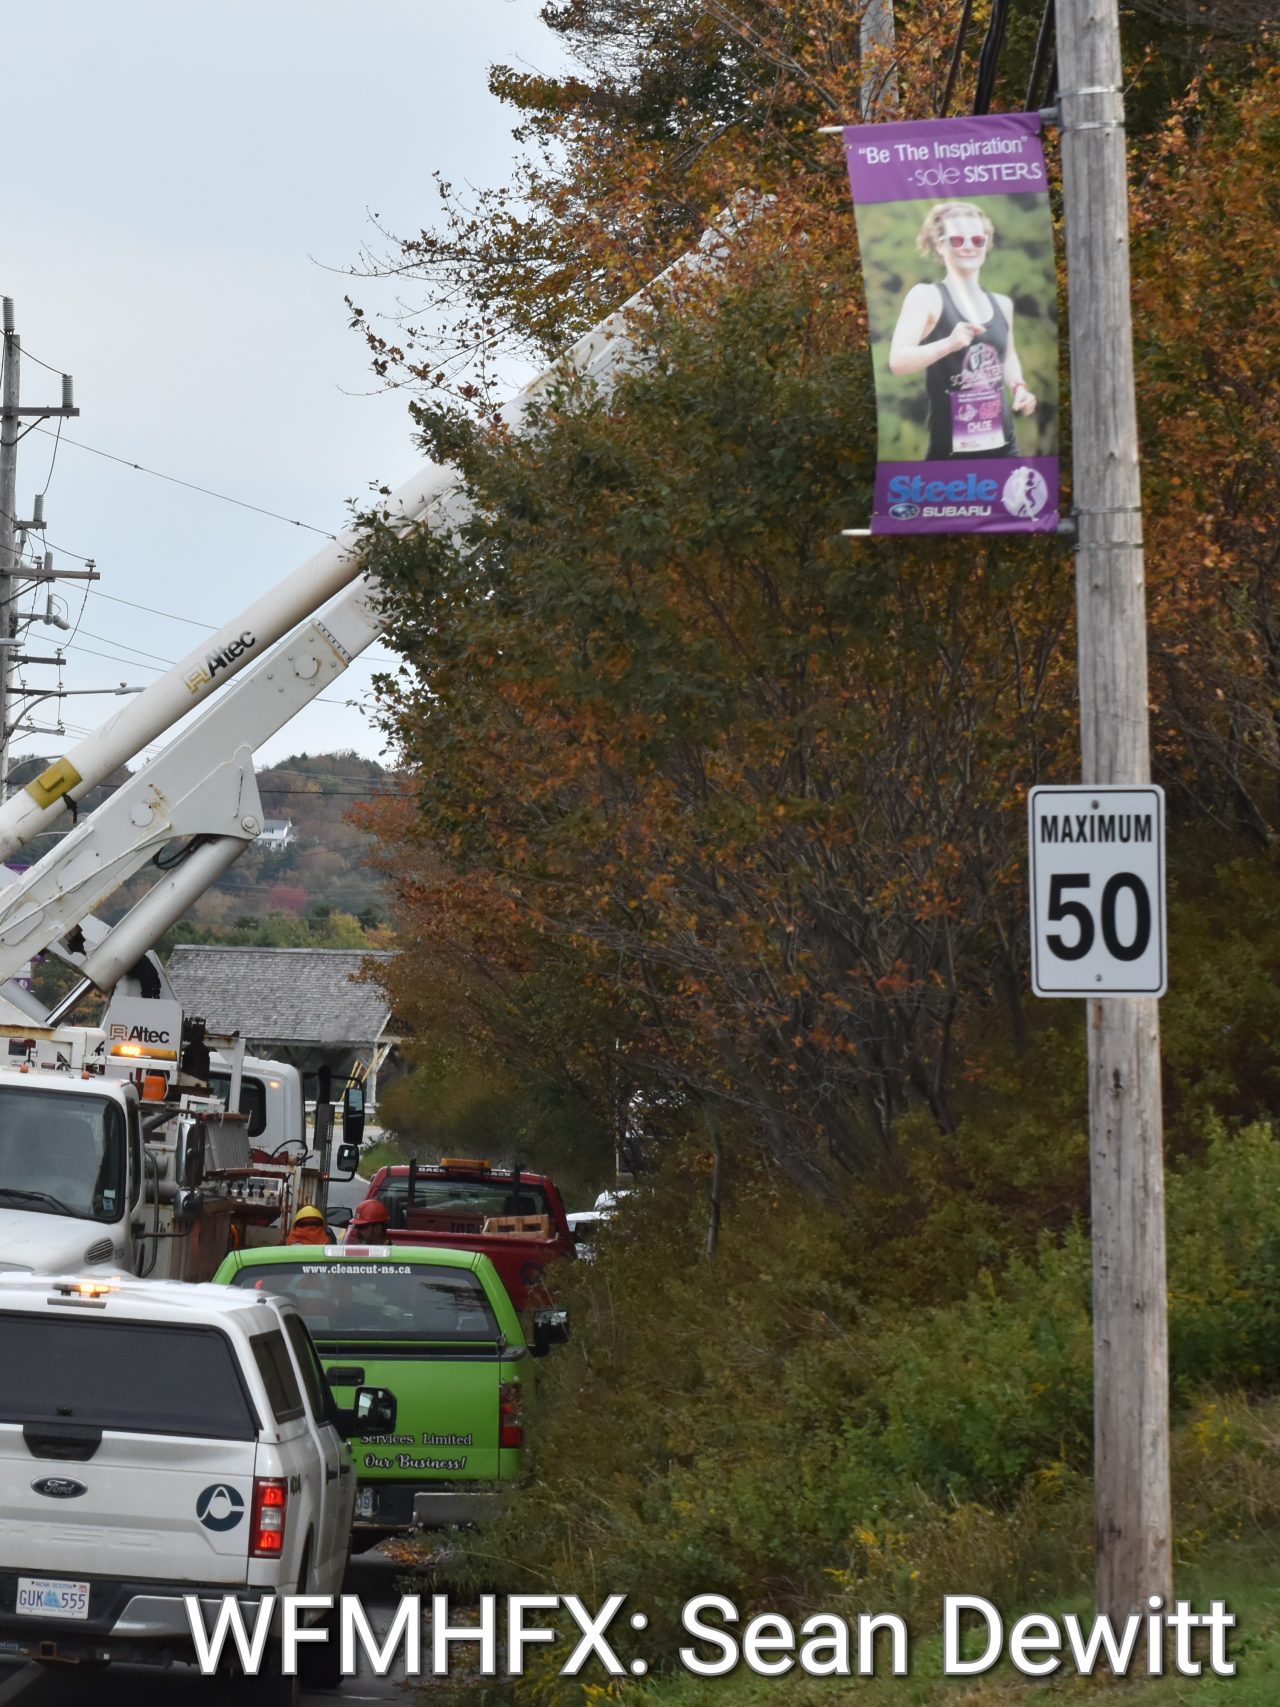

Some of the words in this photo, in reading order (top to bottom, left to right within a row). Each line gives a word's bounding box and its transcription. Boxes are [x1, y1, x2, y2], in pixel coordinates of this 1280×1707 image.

[894, 143, 929, 161] The
[964, 162, 1042, 183] SISTERS
[887, 473, 998, 504] Steele
[922, 505, 992, 517] SUBARU
[204, 630, 256, 678] Altec
[1040, 814, 1152, 843] MAXIMUM
[1045, 872, 1152, 962] 50
[128, 1025, 170, 1044] Altec
[302, 1263, 411, 1275] www.cleancut-ns.ca
[359, 1433, 415, 1445] Services
[423, 1433, 473, 1445] Limited
[364, 1453, 393, 1468] Our
[397, 1454, 467, 1469] Business!
[43, 1479, 75, 1495] Ford
[19, 1589, 44, 1608] GUK
[60, 1592, 87, 1610] 555
